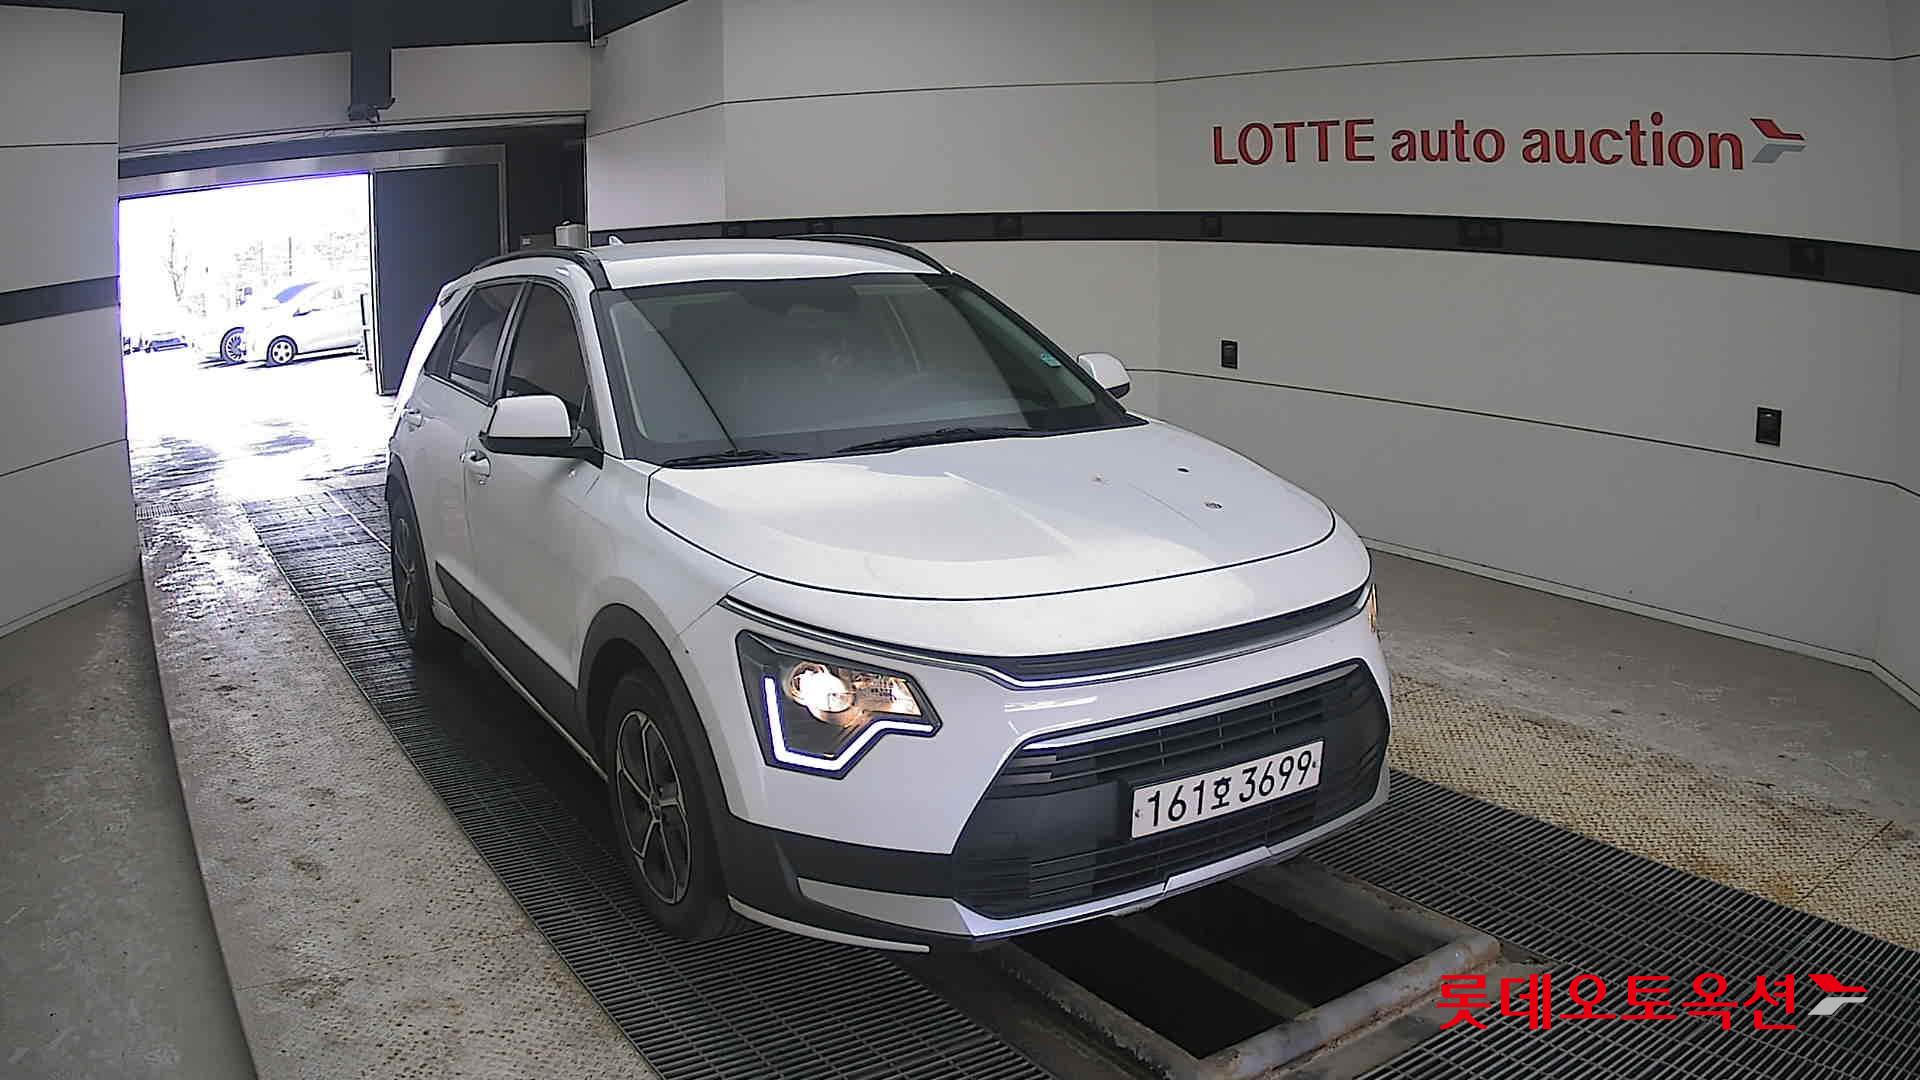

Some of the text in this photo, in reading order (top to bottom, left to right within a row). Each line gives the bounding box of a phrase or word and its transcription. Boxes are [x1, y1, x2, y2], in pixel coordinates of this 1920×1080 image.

[1213, 111, 1744, 170] LOTTE auto auction
[1239, 750, 1313, 803] 3699
